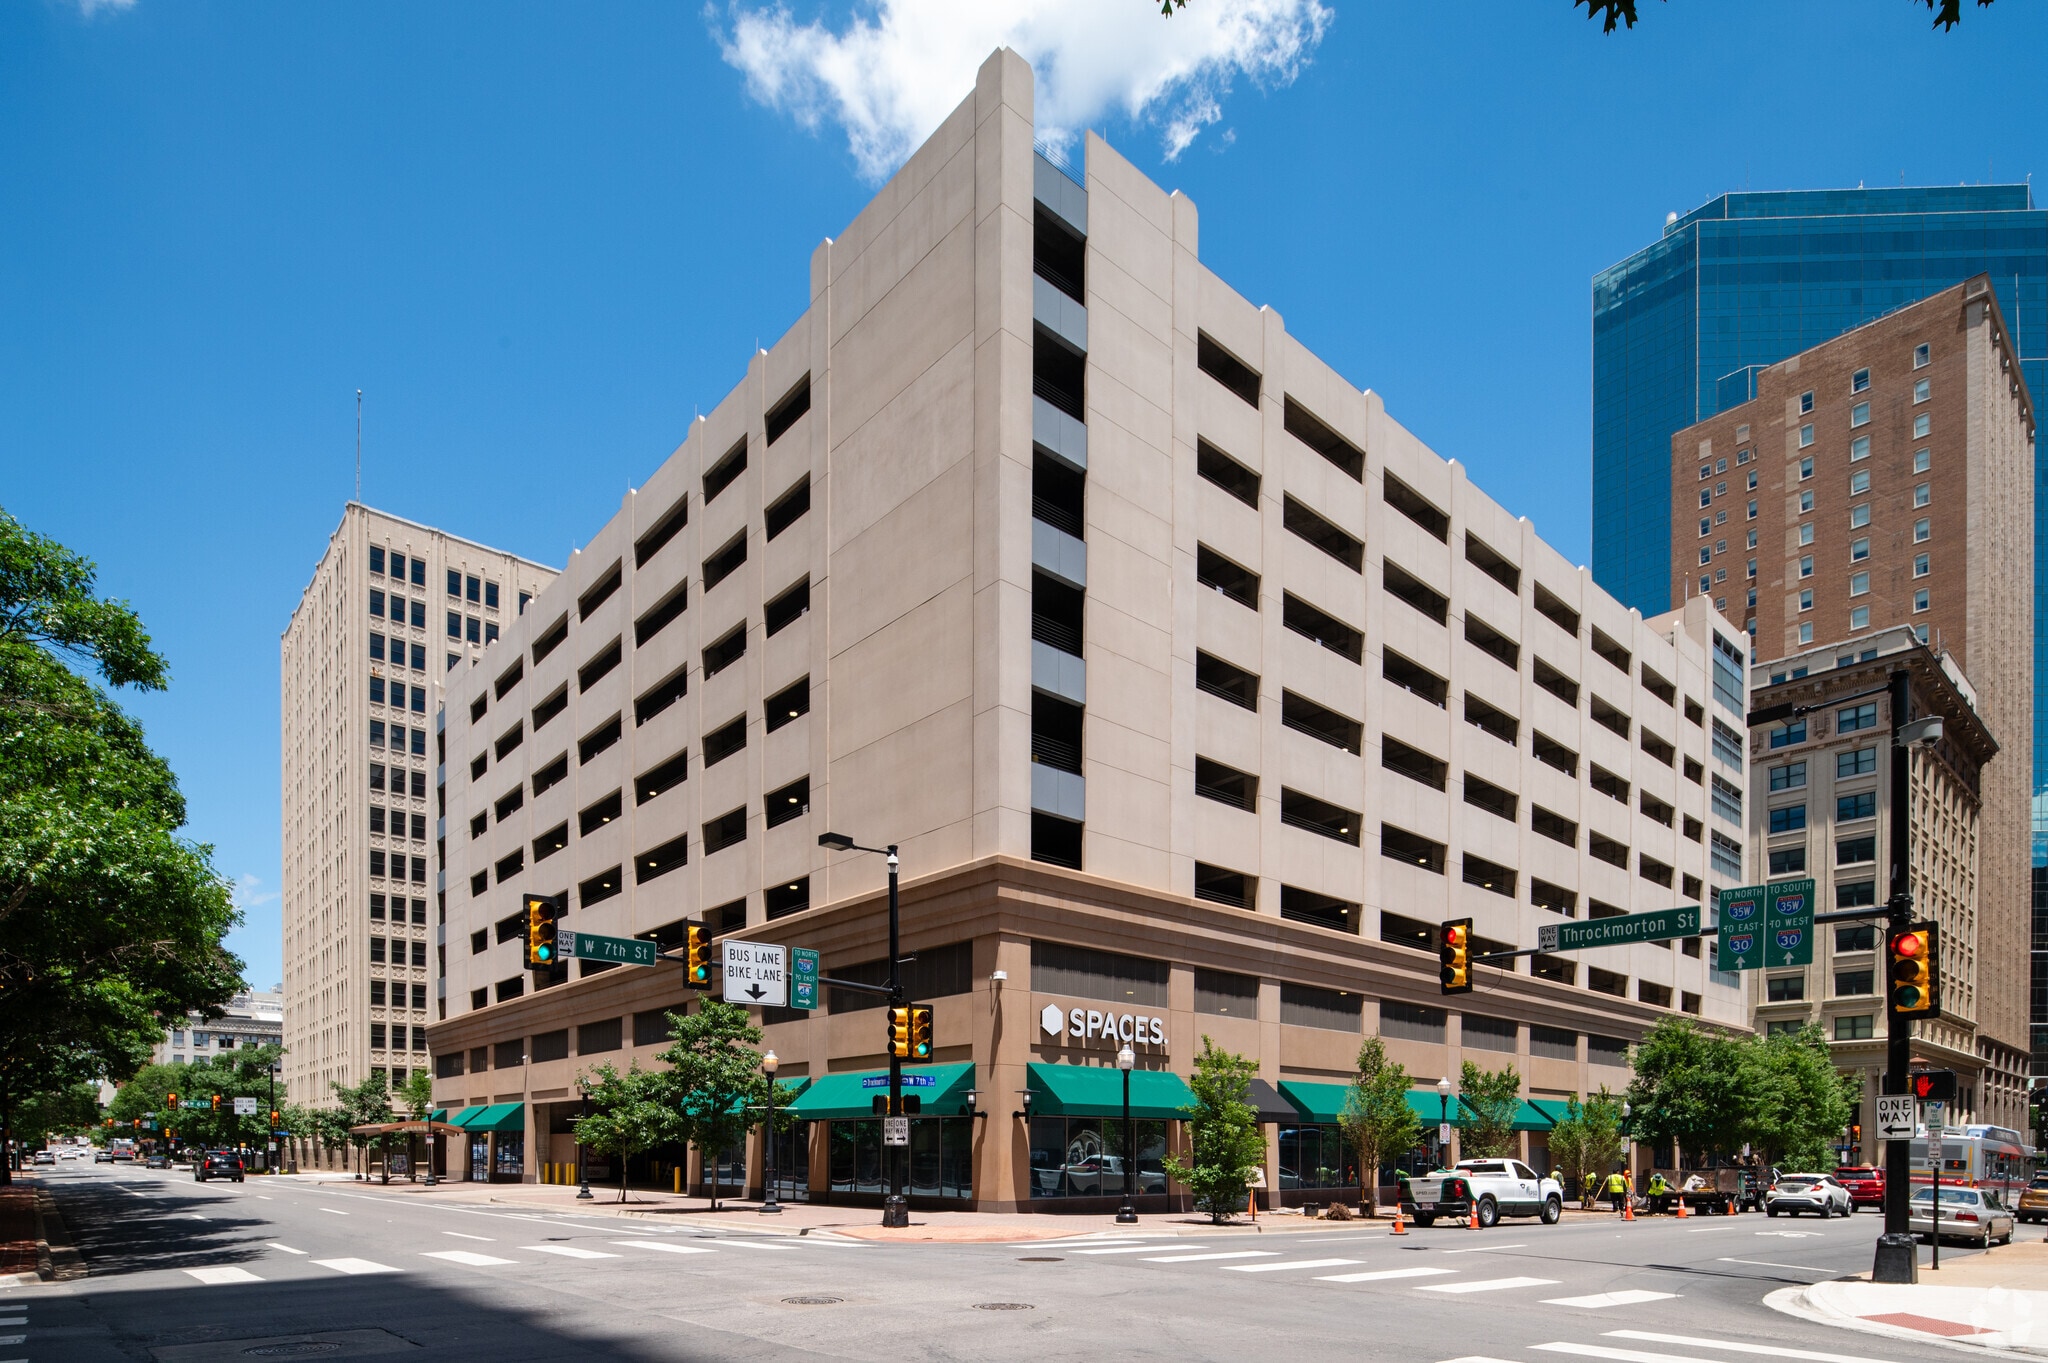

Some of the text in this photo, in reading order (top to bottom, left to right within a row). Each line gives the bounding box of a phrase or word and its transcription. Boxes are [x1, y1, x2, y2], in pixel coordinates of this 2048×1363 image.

[1770, 881, 1812, 894] TO SOUTH
[1723, 888, 1763, 900] TO NORTH
[1780, 900, 1800, 912] 35W
[1732, 906, 1751, 918] 35W
[1563, 912, 1695, 942] Throckmorton St
[1724, 922, 1758, 933] TO EAST
[1770, 916, 1809, 928] TO WEST
[558, 932, 574, 940] ONE
[1540, 926, 1556, 935] ONE
[1541, 934, 1556, 942] WAY
[1780, 935, 1798, 946] 30
[584, 940, 648, 960] W 7th St
[1732, 940, 1749, 950] 30
[730, 948, 780, 965] BUS LANE
[802, 950, 818, 958] NORTH
[728, 966, 782, 982] BIKE LANE
[1069, 1008, 1169, 1045] SPACES.
[908, 1077, 914, 1085] W
[916, 1076, 927, 1086] 7th
[1879, 1100, 1910, 1110] ONE
[1879, 1112, 1911, 1122] WAY
